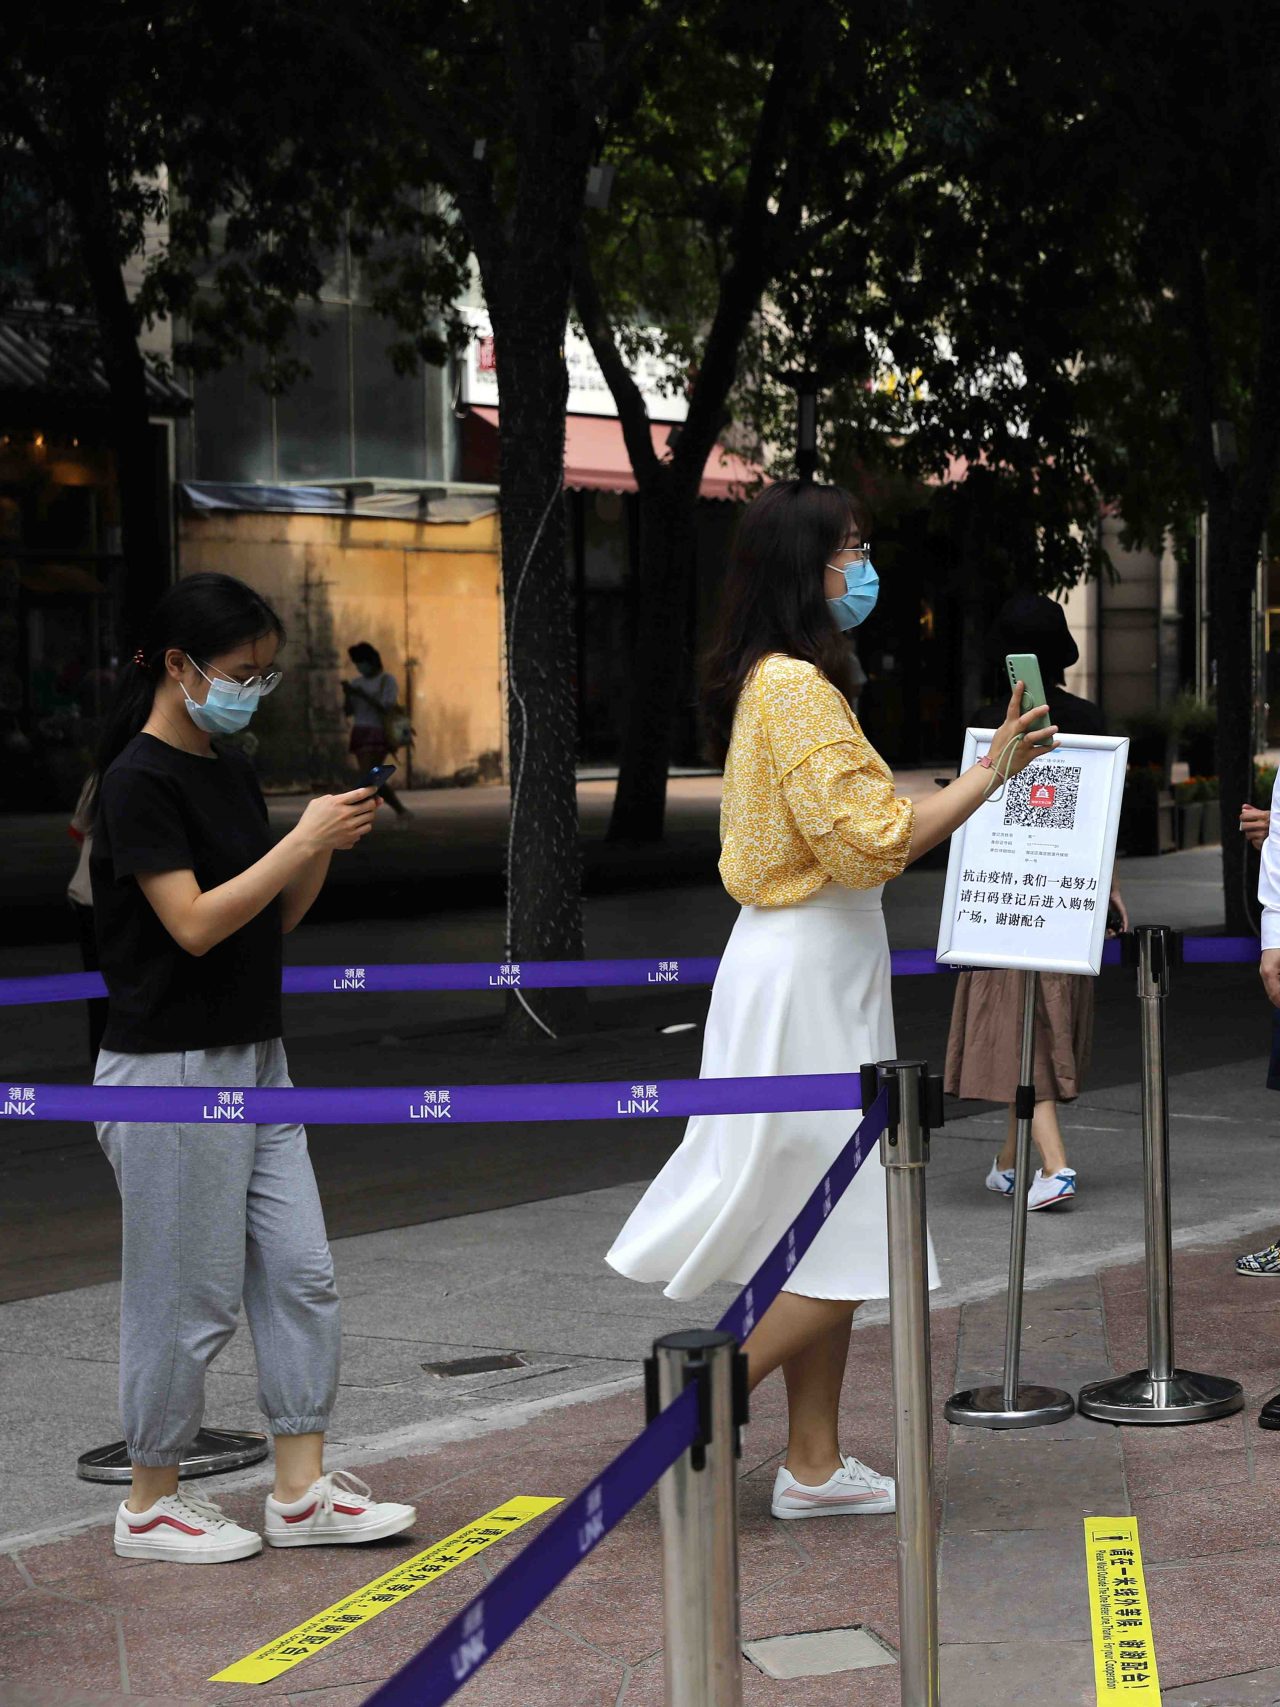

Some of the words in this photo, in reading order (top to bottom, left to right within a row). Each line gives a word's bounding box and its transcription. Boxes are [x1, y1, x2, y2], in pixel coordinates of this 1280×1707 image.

[962, 869, 1097, 891] 抗击疫情，我们一起努力
[960, 889, 1096, 911] 请扫码登记后进入购物
[957, 909, 1046, 928] 广场，谢谢配合
[333, 979, 366, 989] LINK
[489, 975, 521, 985] LINK
[648, 972, 679, 982] LINK
[8, 1087, 36, 1101] 領展
[217, 1091, 244, 1105] 領展
[424, 1090, 450, 1103] 領展
[631, 1085, 658, 1098] 領展
[203, 1105, 244, 1120] LINK
[410, 1105, 451, 1119] LINK
[617, 1100, 659, 1114] LINK
